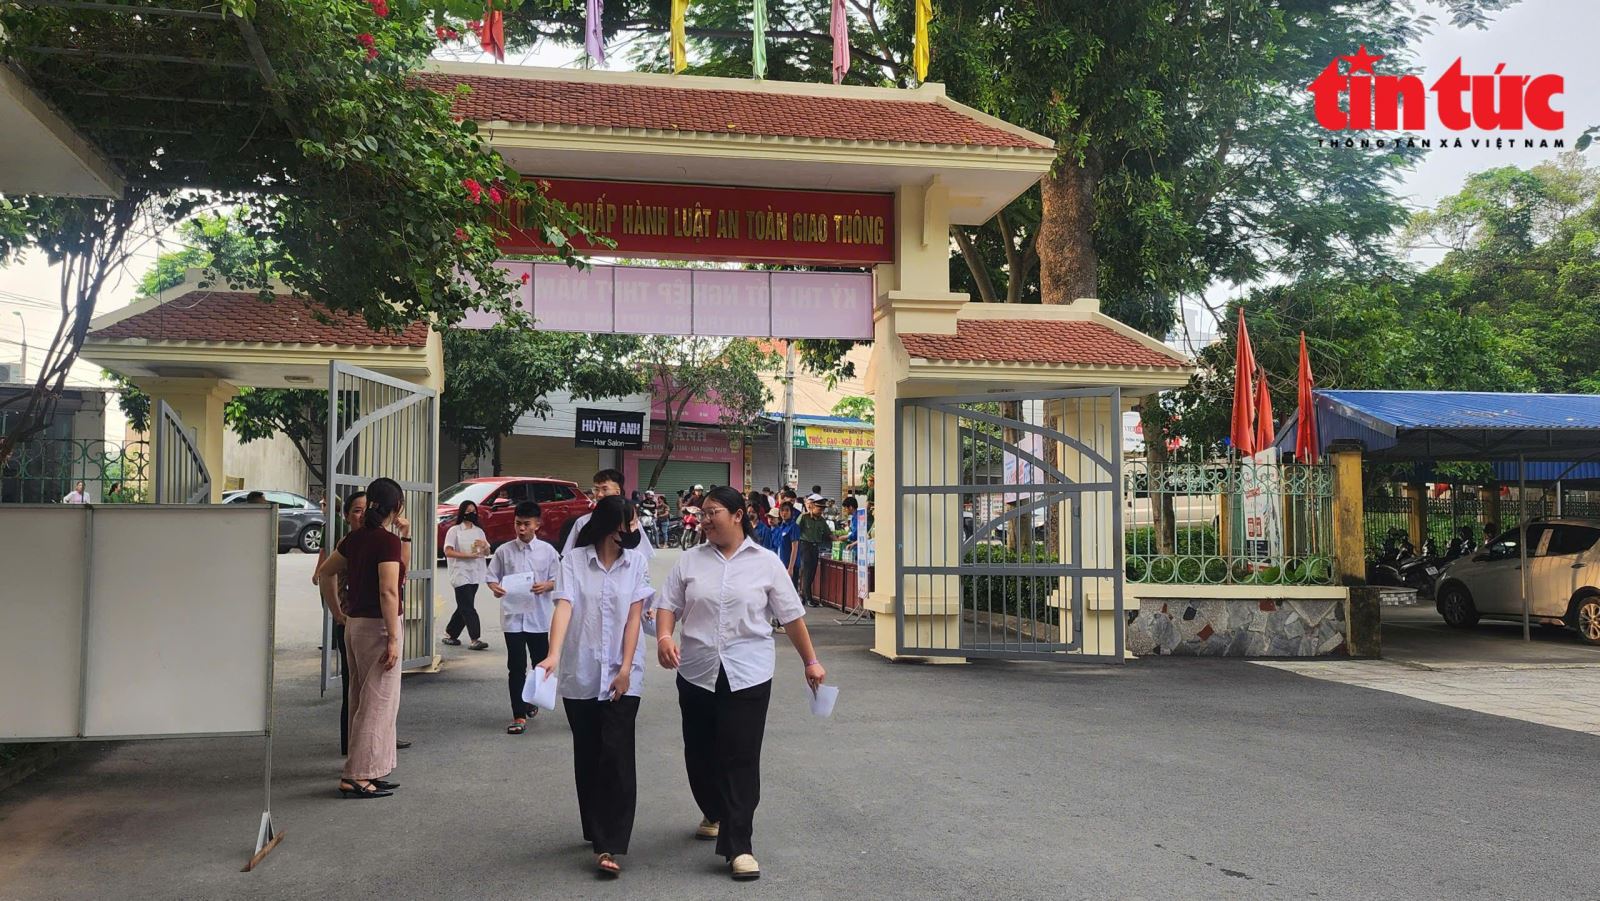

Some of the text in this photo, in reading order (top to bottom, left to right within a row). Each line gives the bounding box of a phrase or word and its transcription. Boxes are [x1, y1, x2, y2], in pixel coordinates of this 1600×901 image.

[622, 200, 668, 236] HÀNH
[673, 201, 712, 243] LUẬT
[717, 209, 740, 240] AN
[746, 205, 788, 241] TOÀN
[793, 212, 828, 243] GIAO
[833, 209, 884, 246] THÔNG
[581, 417, 641, 435] HUỲNH ANH
[593, 438, 625, 447] Hair Salon
